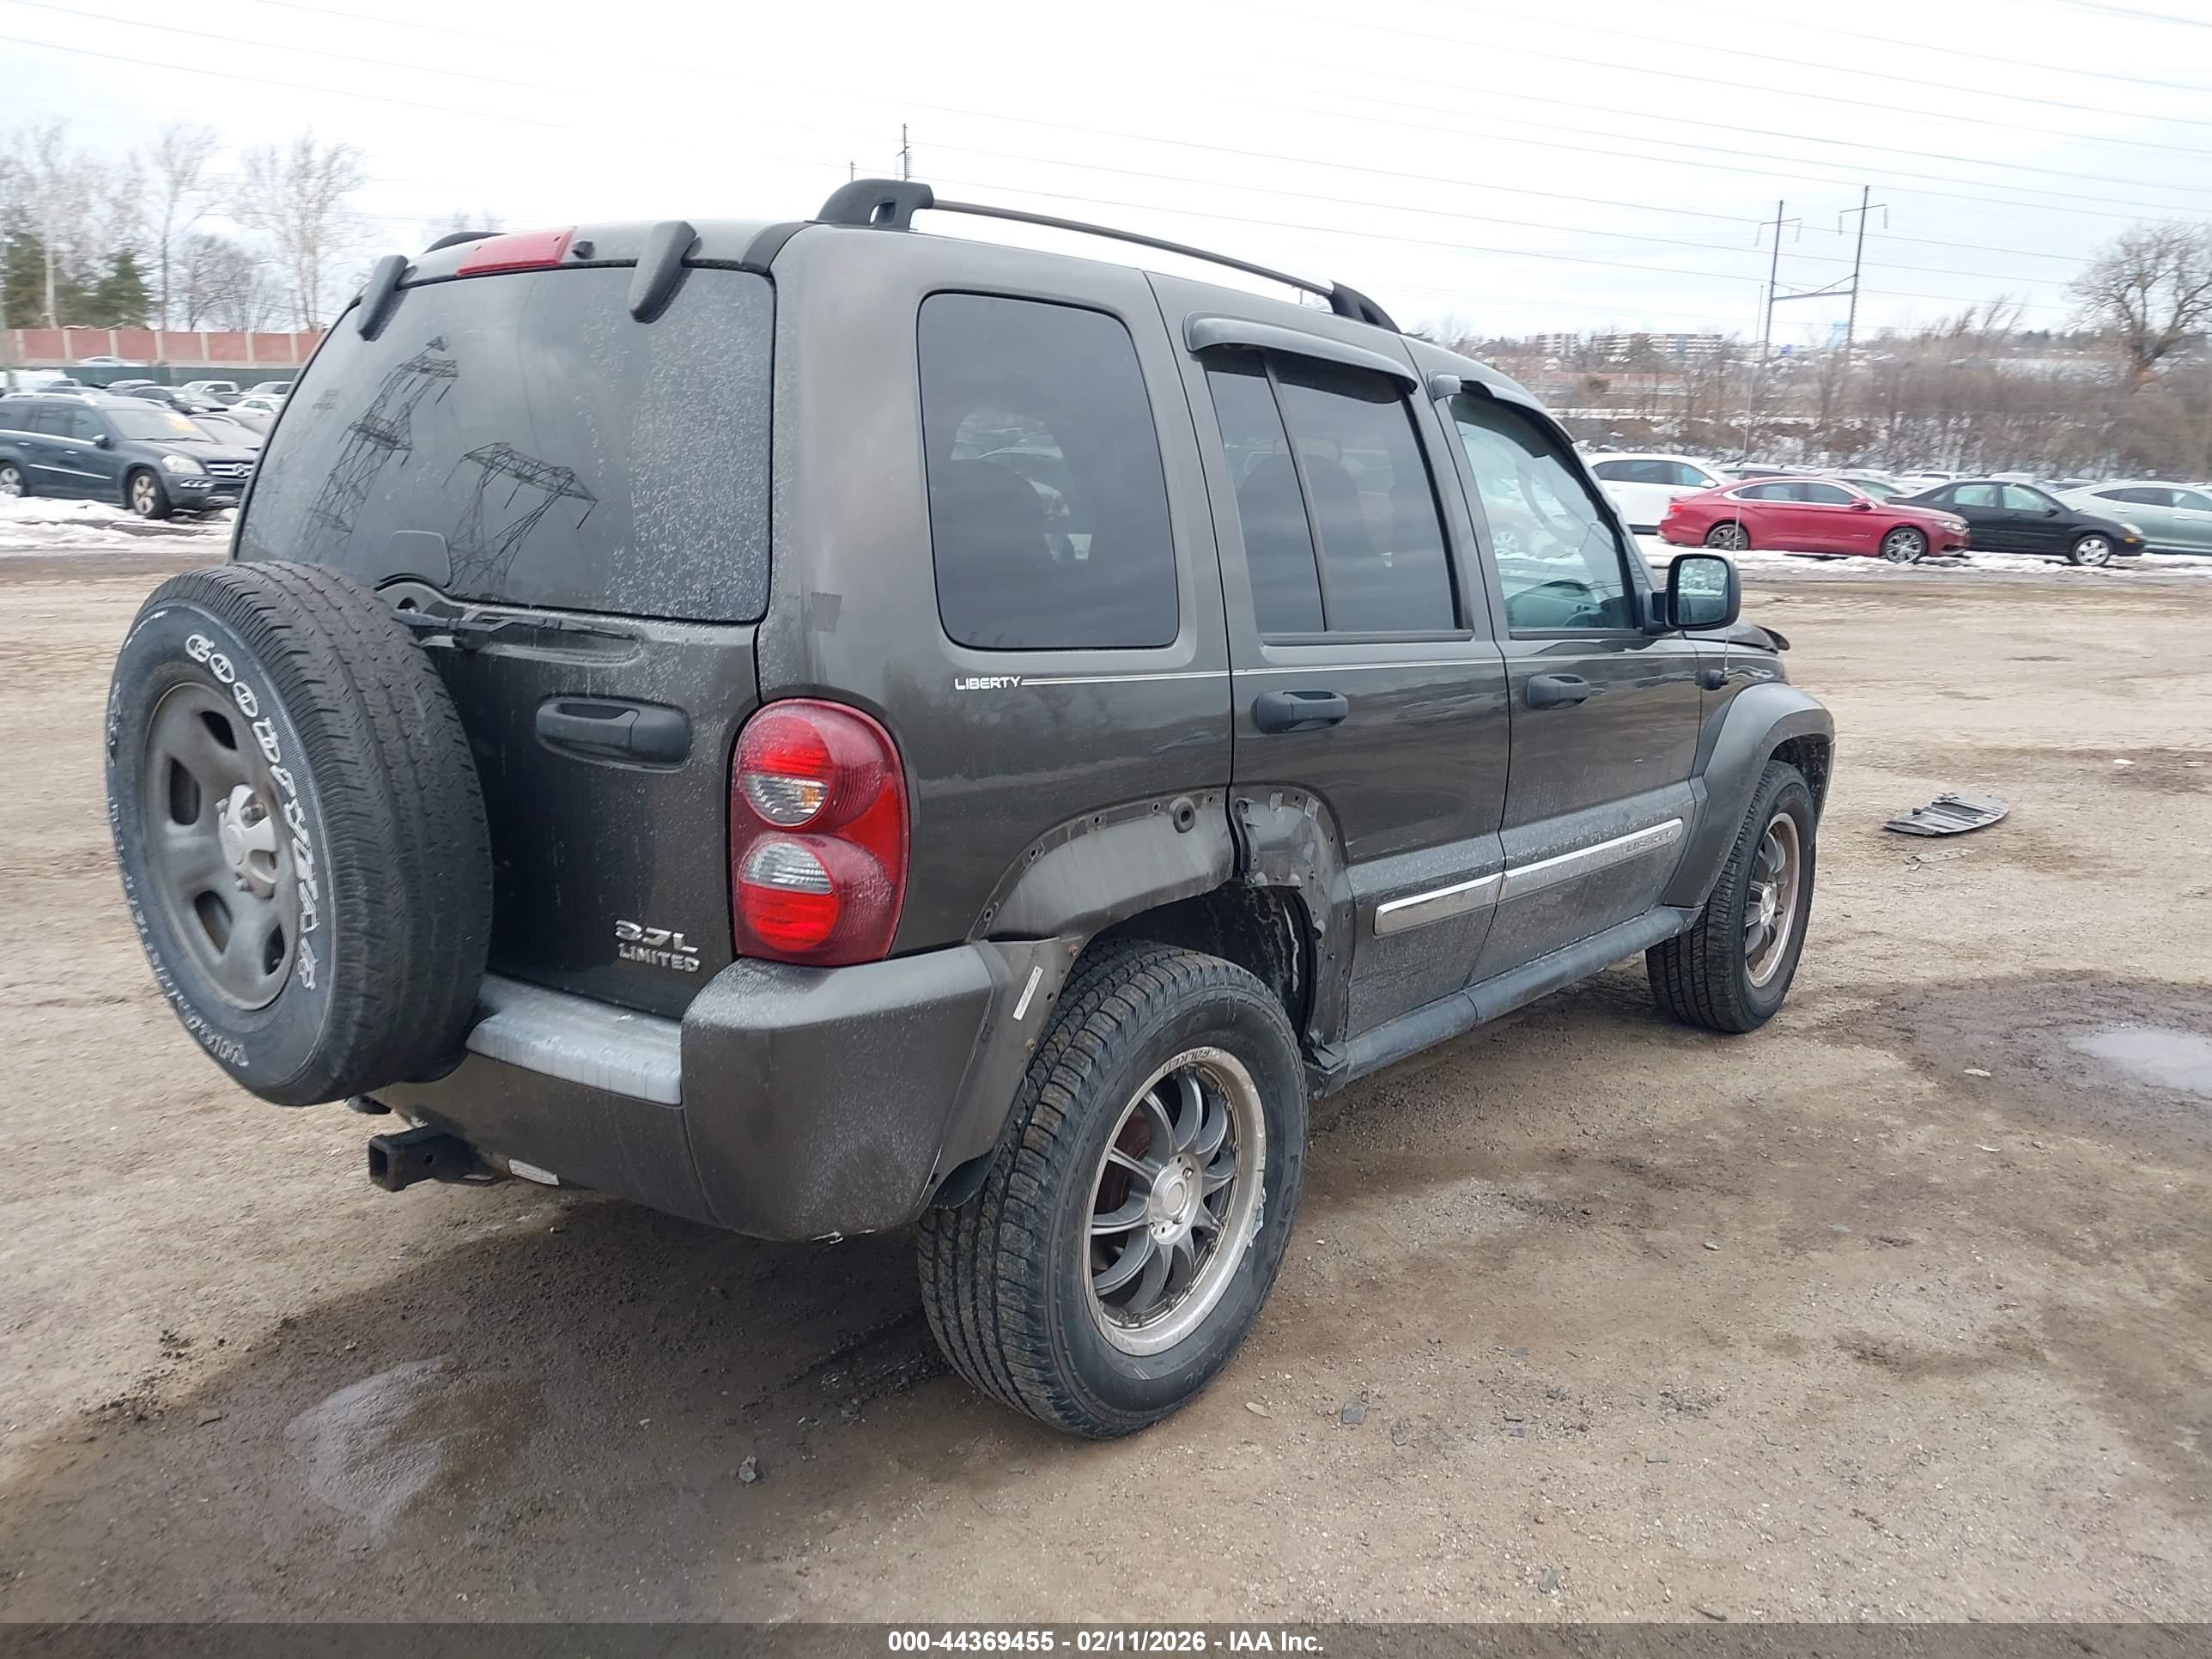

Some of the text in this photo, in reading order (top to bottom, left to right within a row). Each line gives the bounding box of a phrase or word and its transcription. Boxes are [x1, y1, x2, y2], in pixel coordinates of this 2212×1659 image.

[954, 675, 1021, 690] LIBERTY
[185, 634, 320, 990] GOODYEAR
[617, 942, 701, 974] LIMITED
